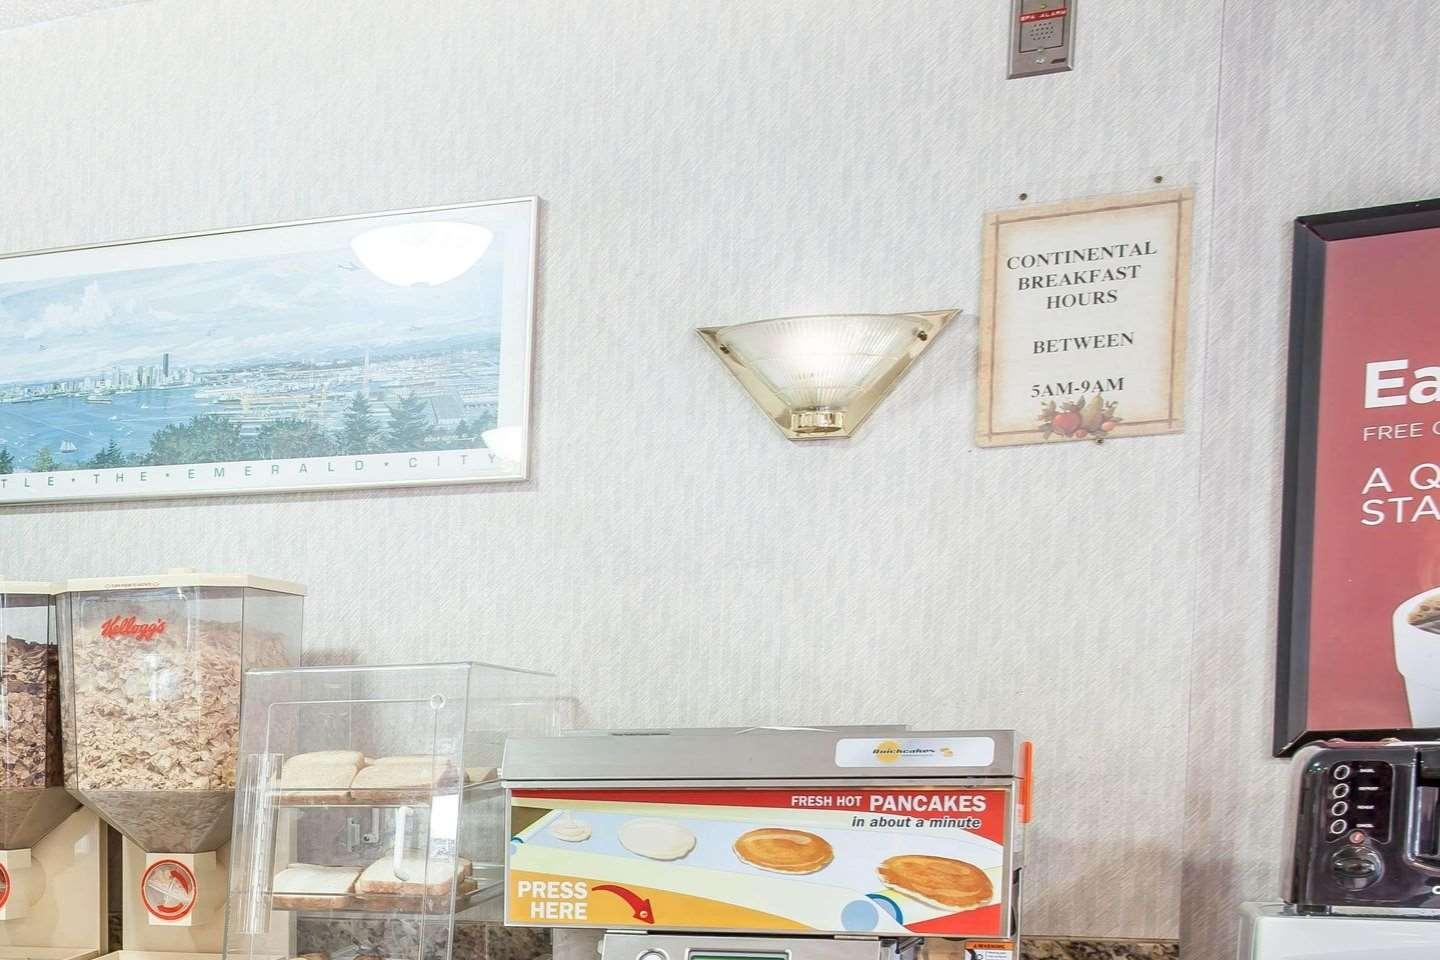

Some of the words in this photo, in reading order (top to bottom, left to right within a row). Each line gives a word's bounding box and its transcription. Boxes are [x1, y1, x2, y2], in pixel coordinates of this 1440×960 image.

[1007, 241, 1158, 270] CONTINENTAL
[1018, 264, 1141, 291] BREAKFAST
[1047, 289, 1118, 309] HOURS
[1033, 331, 1135, 354] BETWEEN
[1031, 377, 1125, 398] 5AM-9AM
[1363, 422, 1425, 442] FREE
[93, 471, 147, 485] THE
[187, 459, 364, 479] EMERALD
[408, 453, 496, 468] CITY
[1361, 466, 1393, 495] A
[100, 615, 166, 641] Kellogg's
[791, 795, 832, 807] FRESH
[836, 795, 862, 807] HOT
[869, 795, 987, 813] PANCAKES
[851, 815, 865, 828] in
[869, 815, 911, 828] about
[915, 818, 924, 828] a
[928, 815, 981, 829] minute
[517, 880, 588, 899] PRESS
[530, 901, 589, 920] HERE
